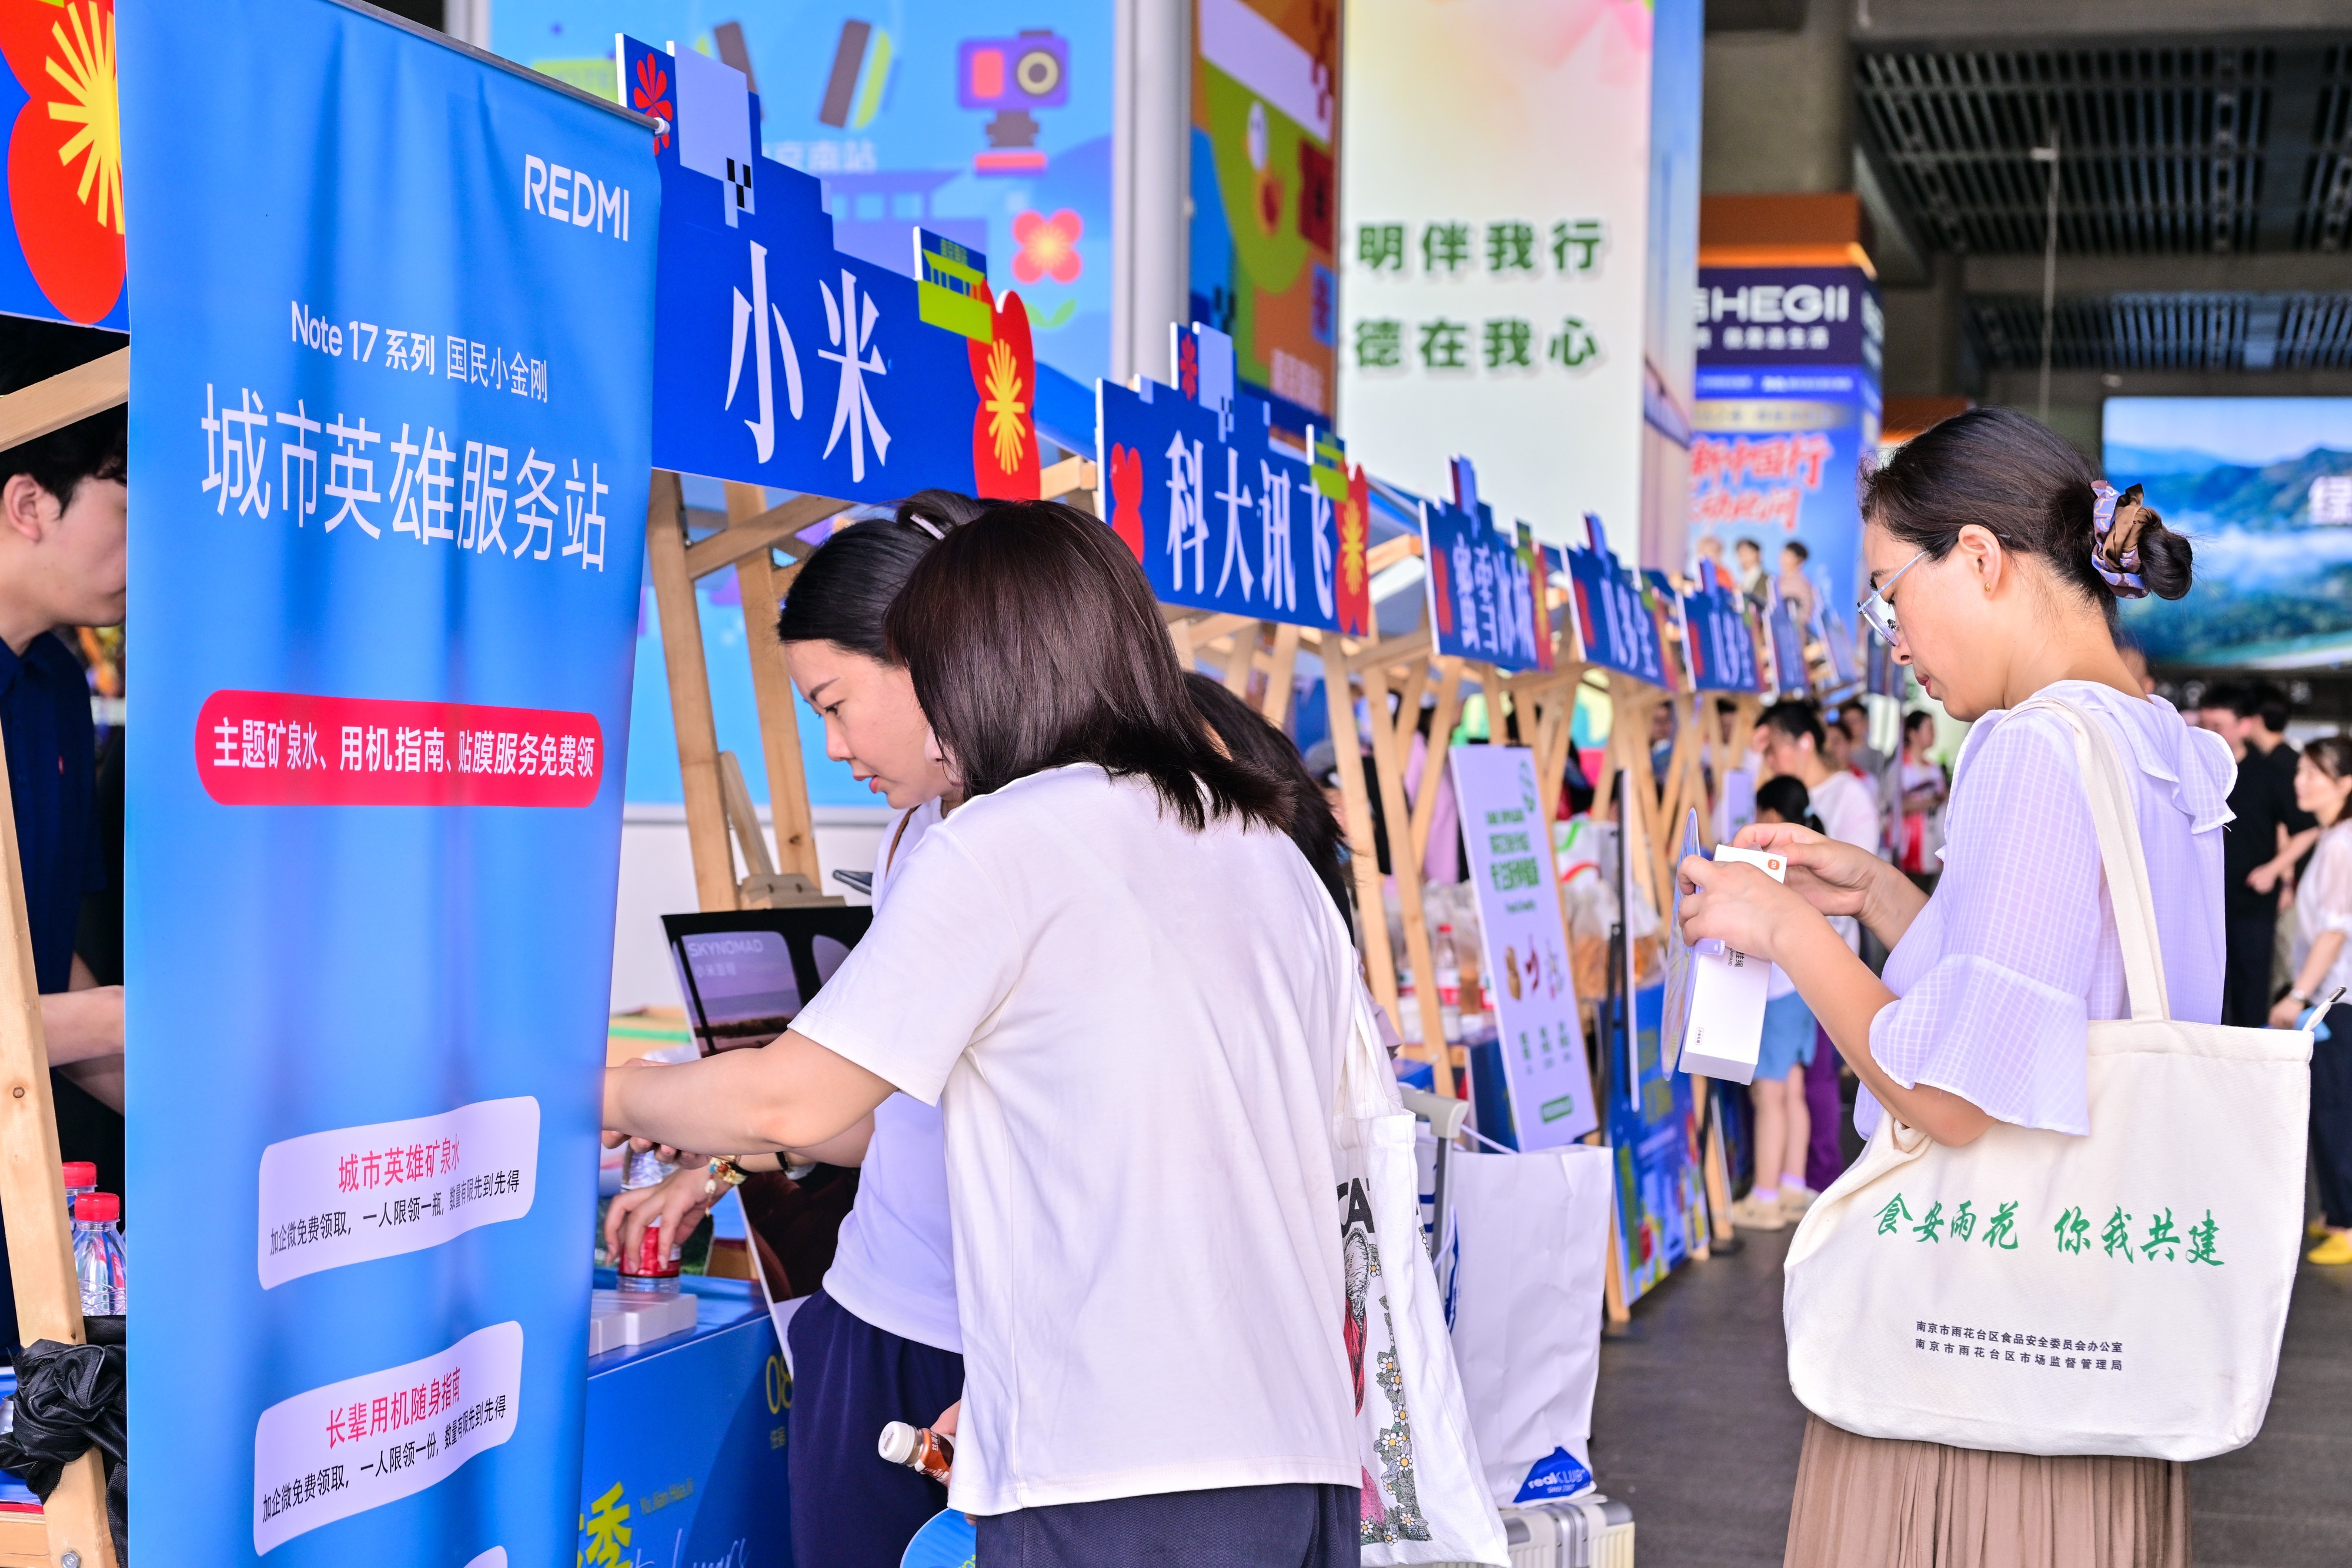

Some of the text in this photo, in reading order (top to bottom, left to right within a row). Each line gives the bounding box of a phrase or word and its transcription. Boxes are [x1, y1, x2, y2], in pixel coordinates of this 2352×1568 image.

[524, 153, 629, 242] REDMI
[1358, 221, 1601, 271] 明伴我行
[292, 300, 548, 403] Note 17 系列 国民小金刚
[724, 239, 892, 483] 小米
[1355, 318, 1598, 369] 德在我心
[201, 382, 610, 573] 城市英雄服务站
[1165, 430, 1333, 621] 科大讯飞
[688, 940, 764, 958] SKYNOMAD
[339, 1134, 460, 1193] 城市英雄矿泉水
[1873, 1192, 2225, 1266] 食安雨花 你我共建
[1915, 1338, 2122, 1371] 南京市雨花台区市场监督管理局
[1916, 1320, 2123, 1353] 南京市雨花台区食品安全委员会办公室
[326, 1366, 461, 1449] 长辈用机随身指南
